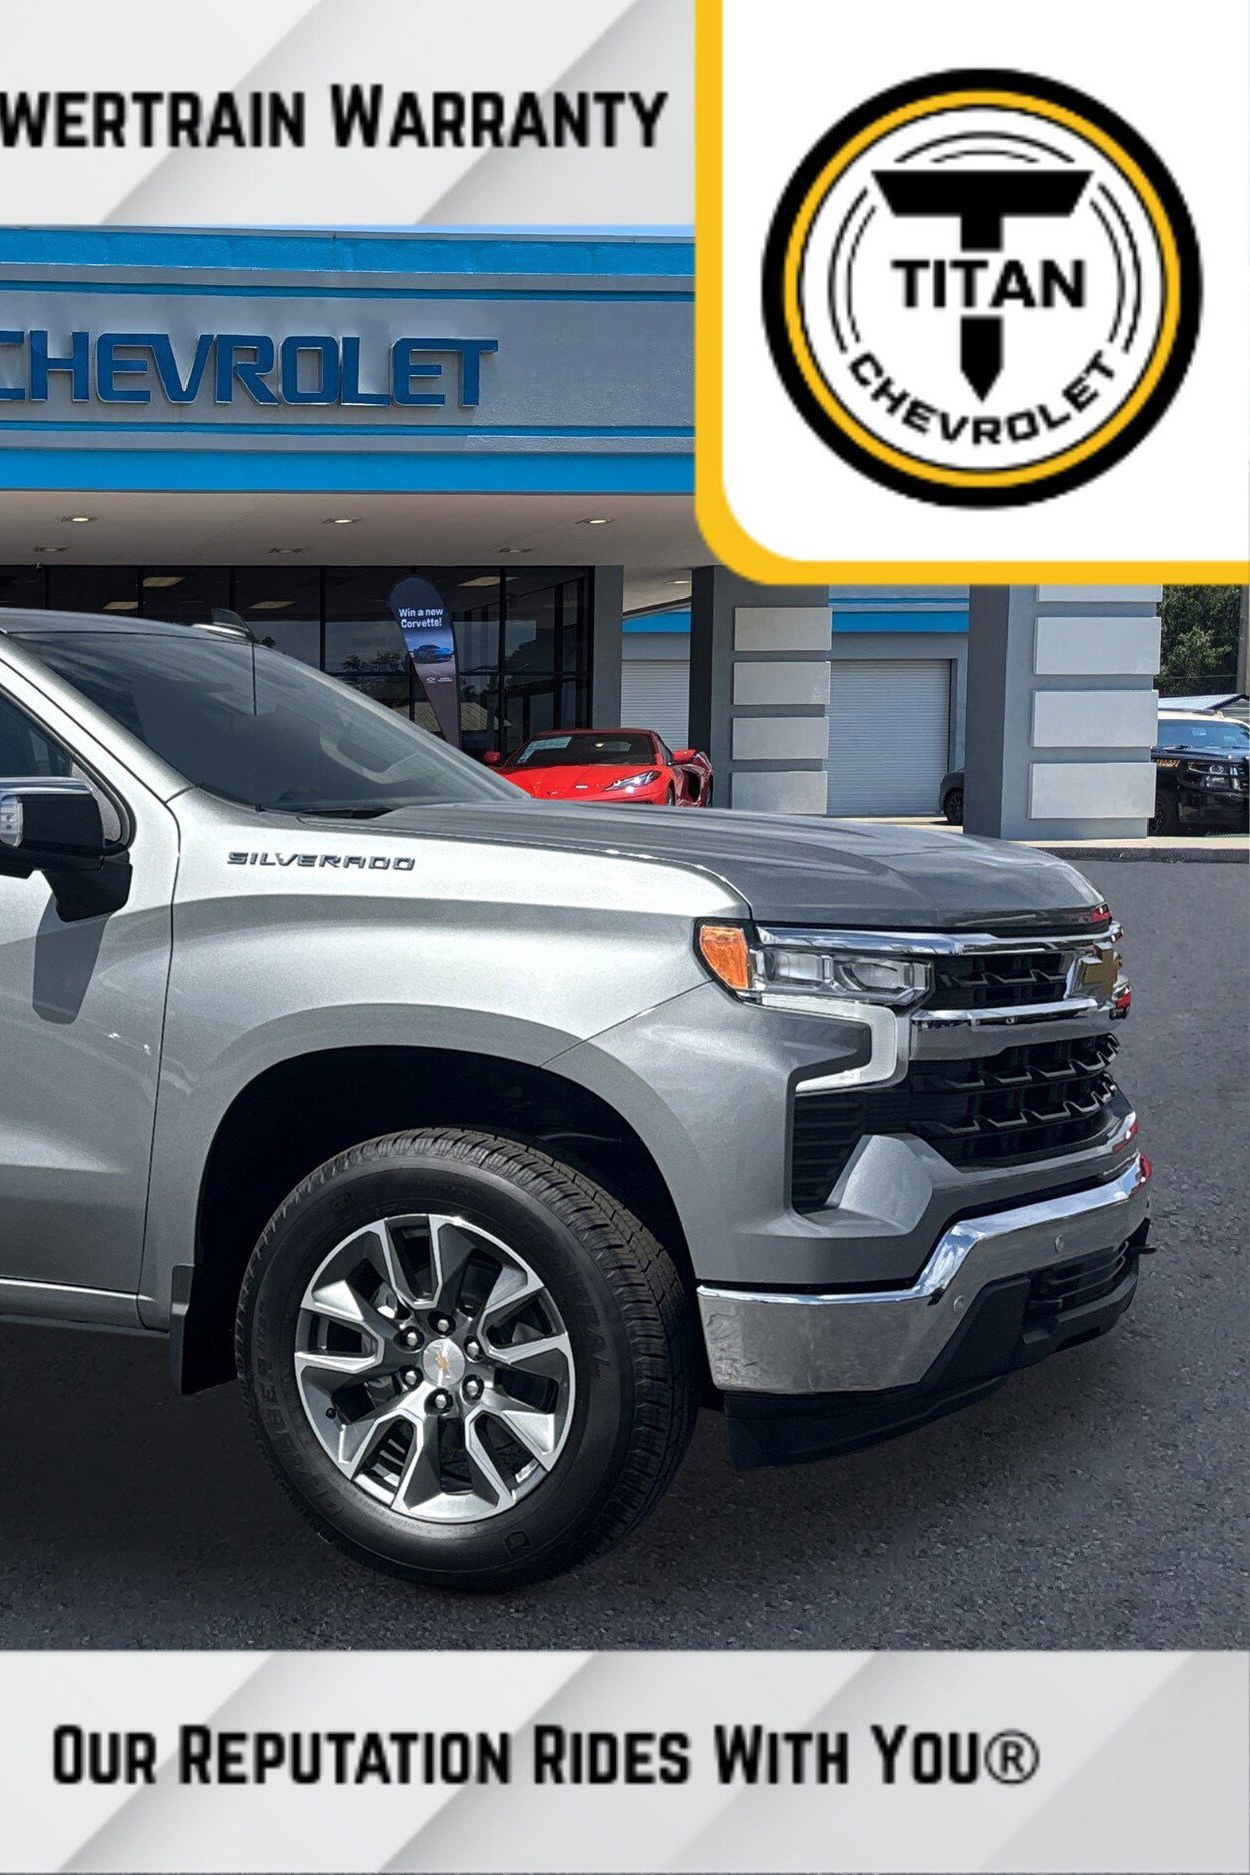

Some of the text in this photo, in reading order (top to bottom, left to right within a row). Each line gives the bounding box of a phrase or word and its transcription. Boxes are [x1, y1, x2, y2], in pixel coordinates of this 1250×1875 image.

[398, 608, 444, 618] Win a new
[401, 617, 442, 628] Corvette!
[226, 851, 417, 872] SILVERADO
